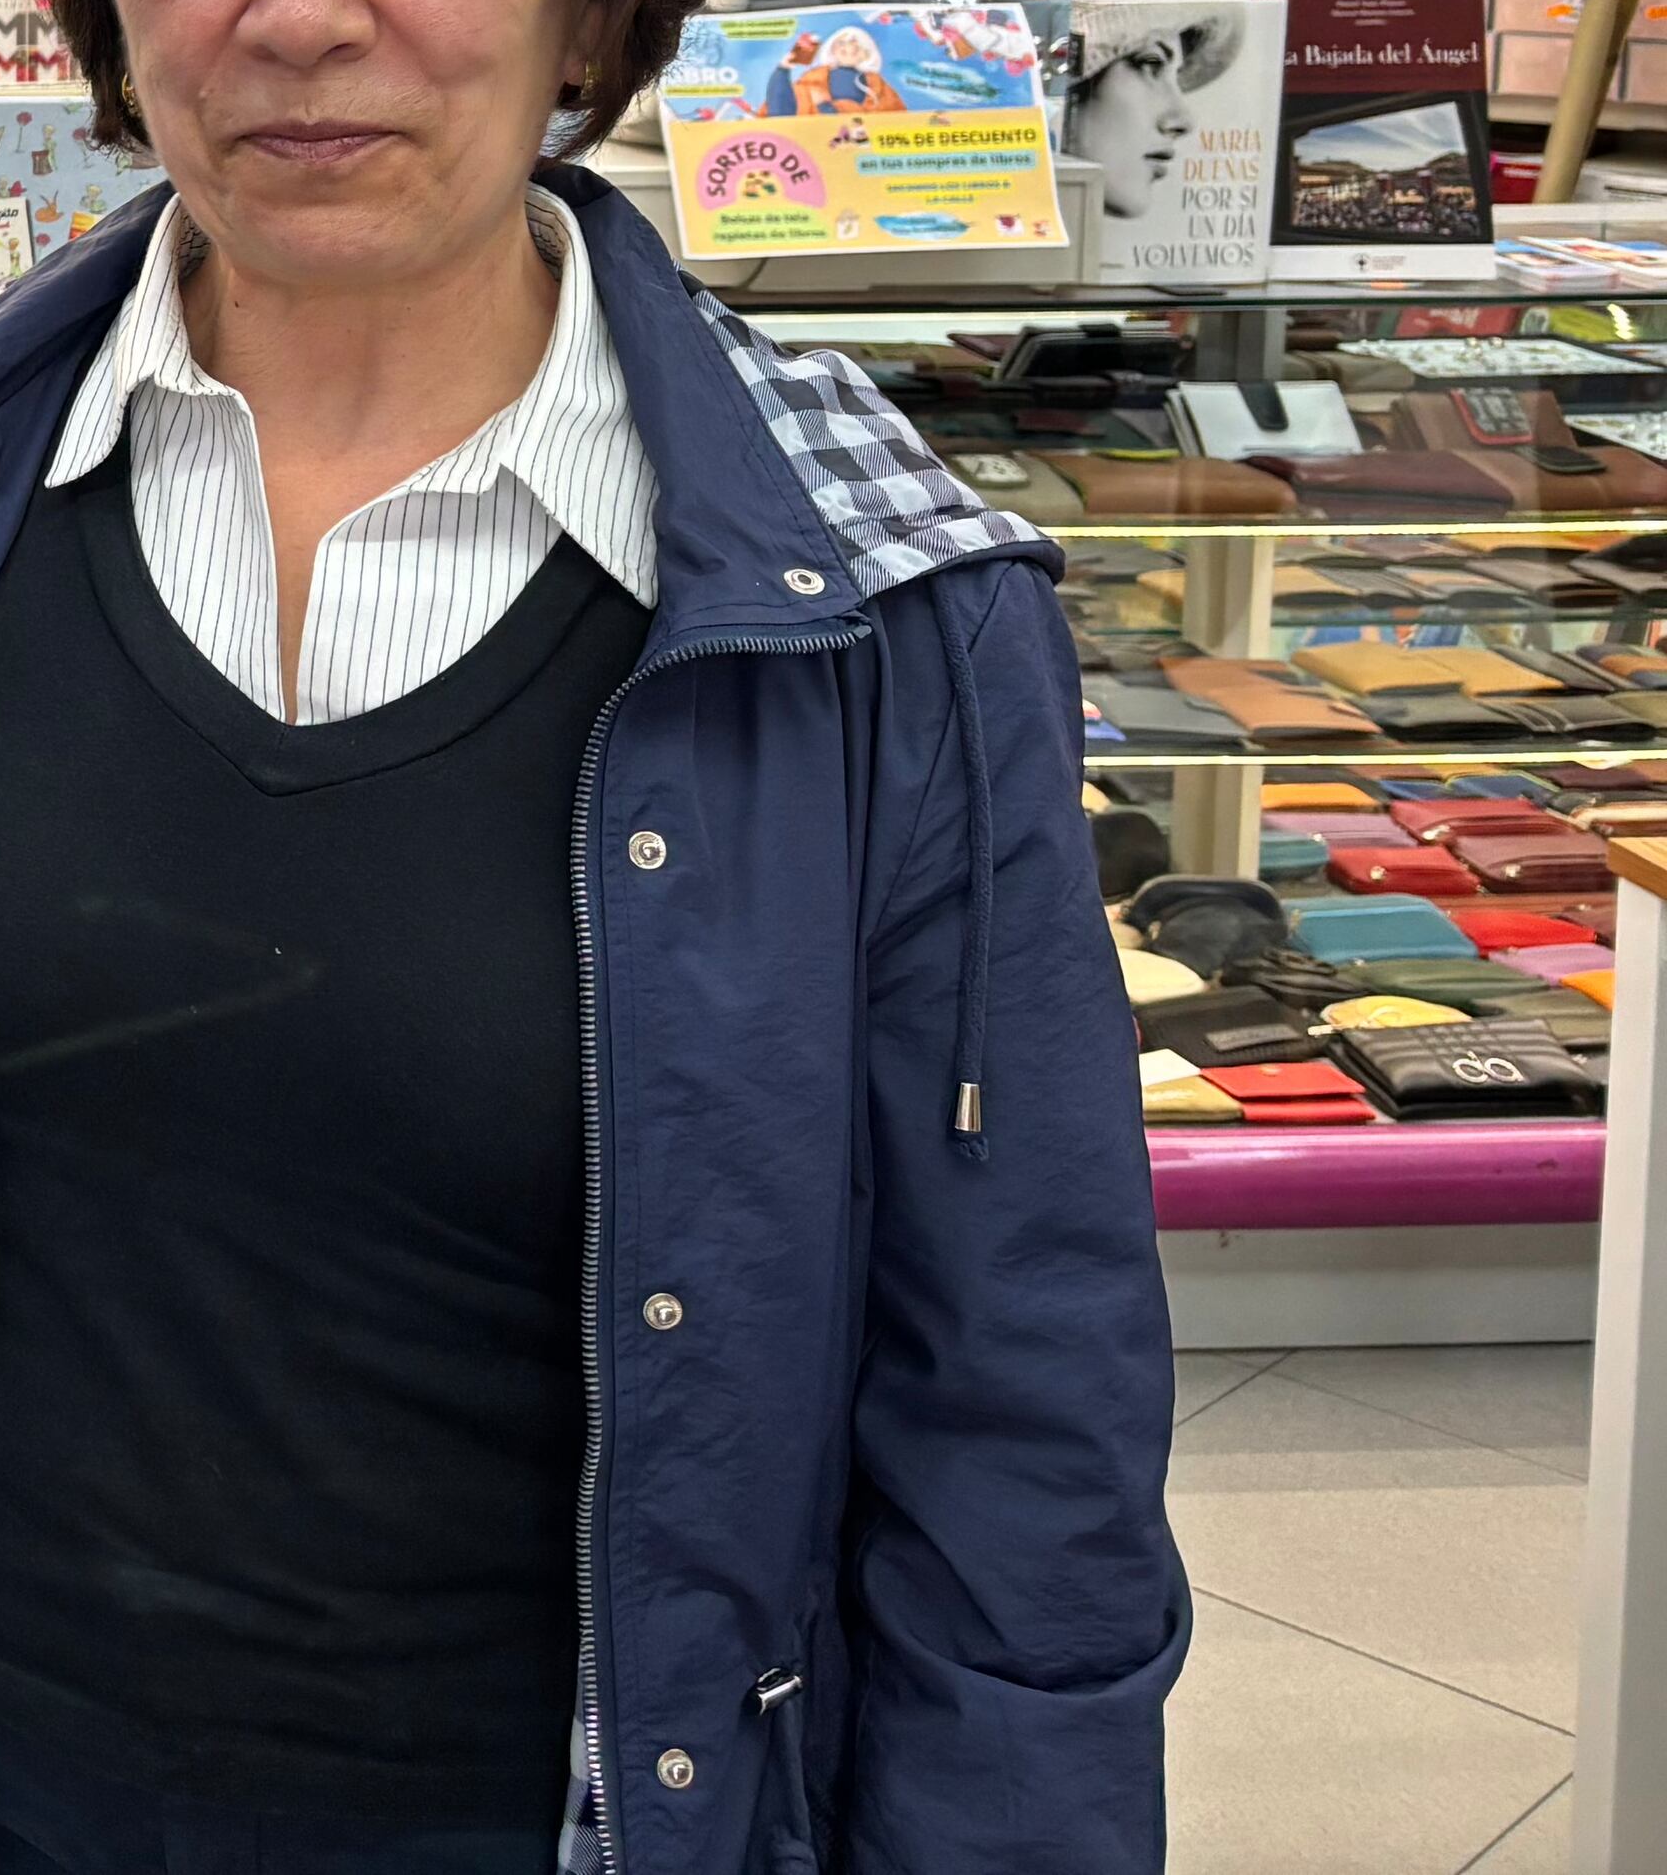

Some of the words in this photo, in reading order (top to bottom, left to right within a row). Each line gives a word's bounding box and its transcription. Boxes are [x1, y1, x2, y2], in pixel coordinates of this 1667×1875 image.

[1305, 43, 1373, 69] Bajada
[1379, 42, 1410, 65] del
[1417, 39, 1479, 68] Ángel
[879, 130, 910, 147] 10%
[915, 131, 935, 146] DE
[940, 128, 1037, 147] DESCUENTO
[1198, 128, 1262, 153] MARÍA
[707, 140, 778, 198] SORTEO
[780, 153, 811, 185] DE
[861, 158, 877, 171] en
[880, 156, 903, 170] tus
[907, 155, 967, 172] compras
[970, 154, 986, 167] de
[990, 152, 1031, 166] libros
[1184, 157, 1259, 182] DUEÑAS
[1182, 186, 1230, 210] POR
[1240, 186, 1257, 209] SI
[788, 227, 826, 239] libros
[1189, 216, 1217, 240] UN
[1224, 212, 1255, 238] DÍA
[1132, 242, 1254, 270] VOLVEMOS
